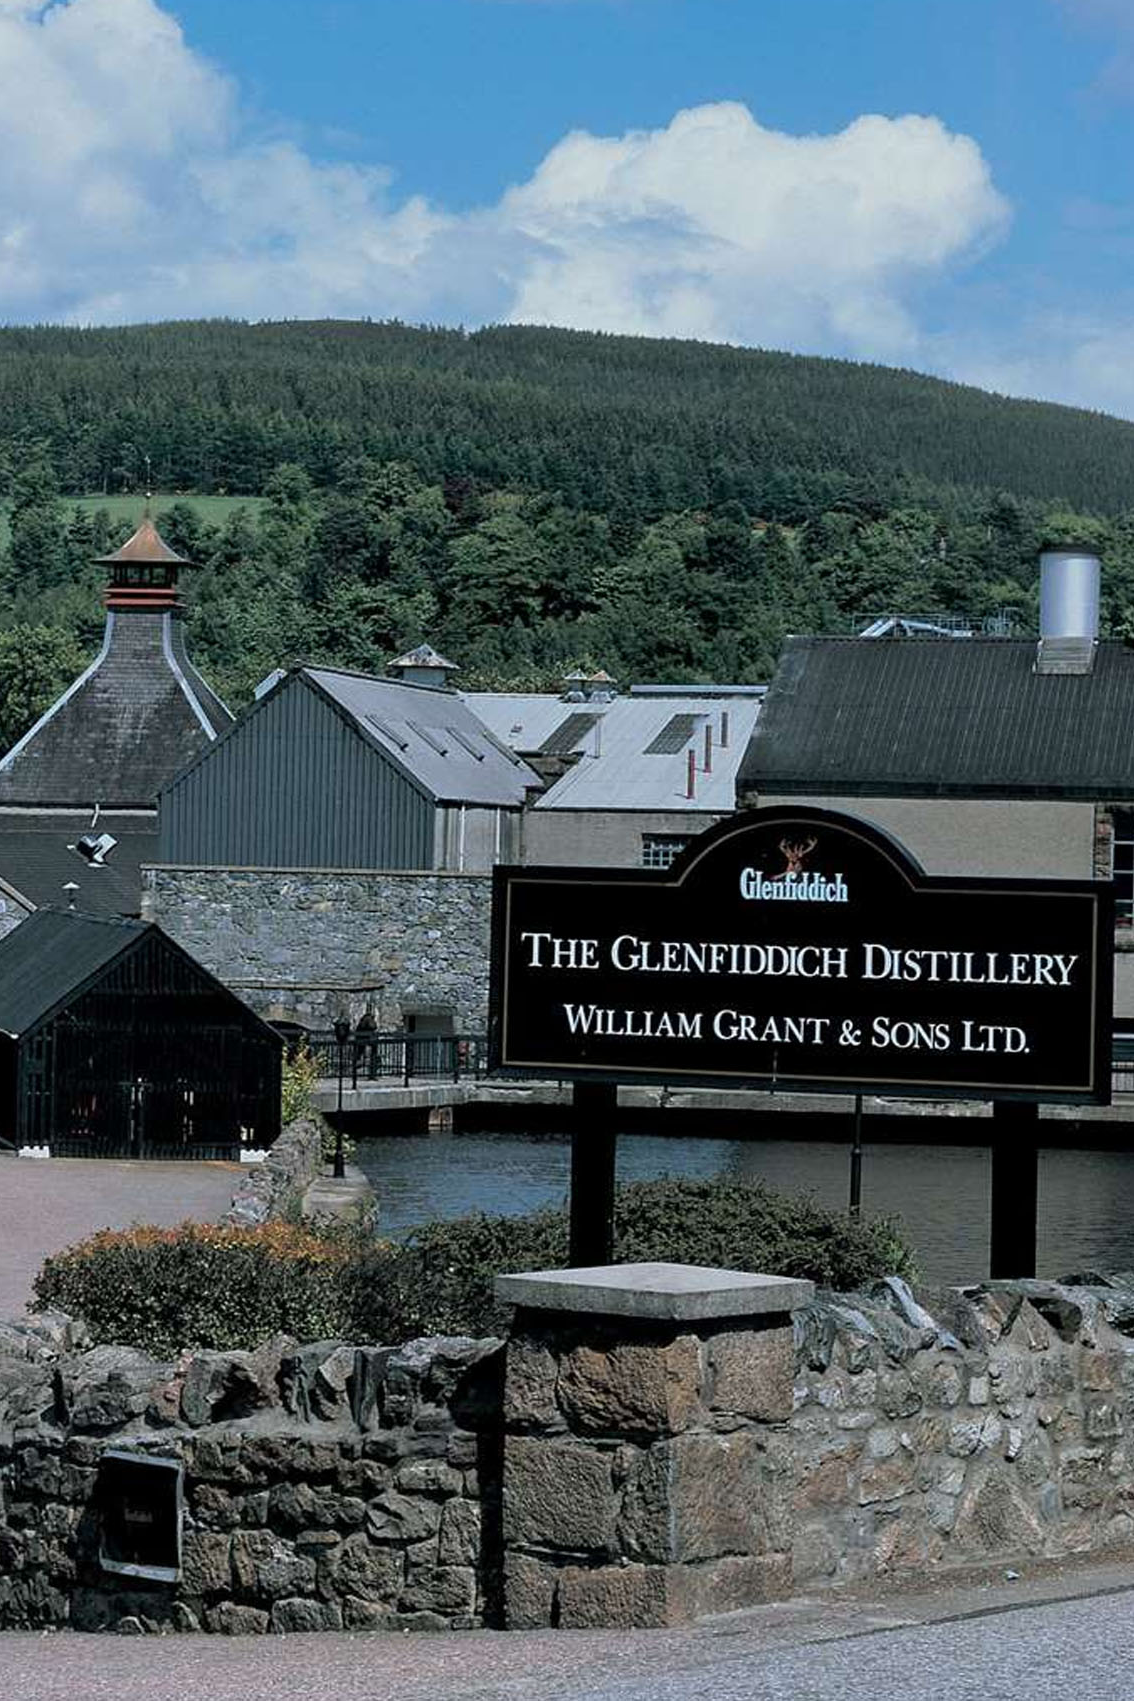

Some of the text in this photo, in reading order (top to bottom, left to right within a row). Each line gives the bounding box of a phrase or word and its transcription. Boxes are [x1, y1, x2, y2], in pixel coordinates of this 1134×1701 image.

[739, 868, 848, 902] Glenfiddich
[521, 932, 1078, 985] THE GLENFIDDICH DISTILLERY
[563, 1004, 1030, 1054] WILLIAM GRANT & SONS LTD.
